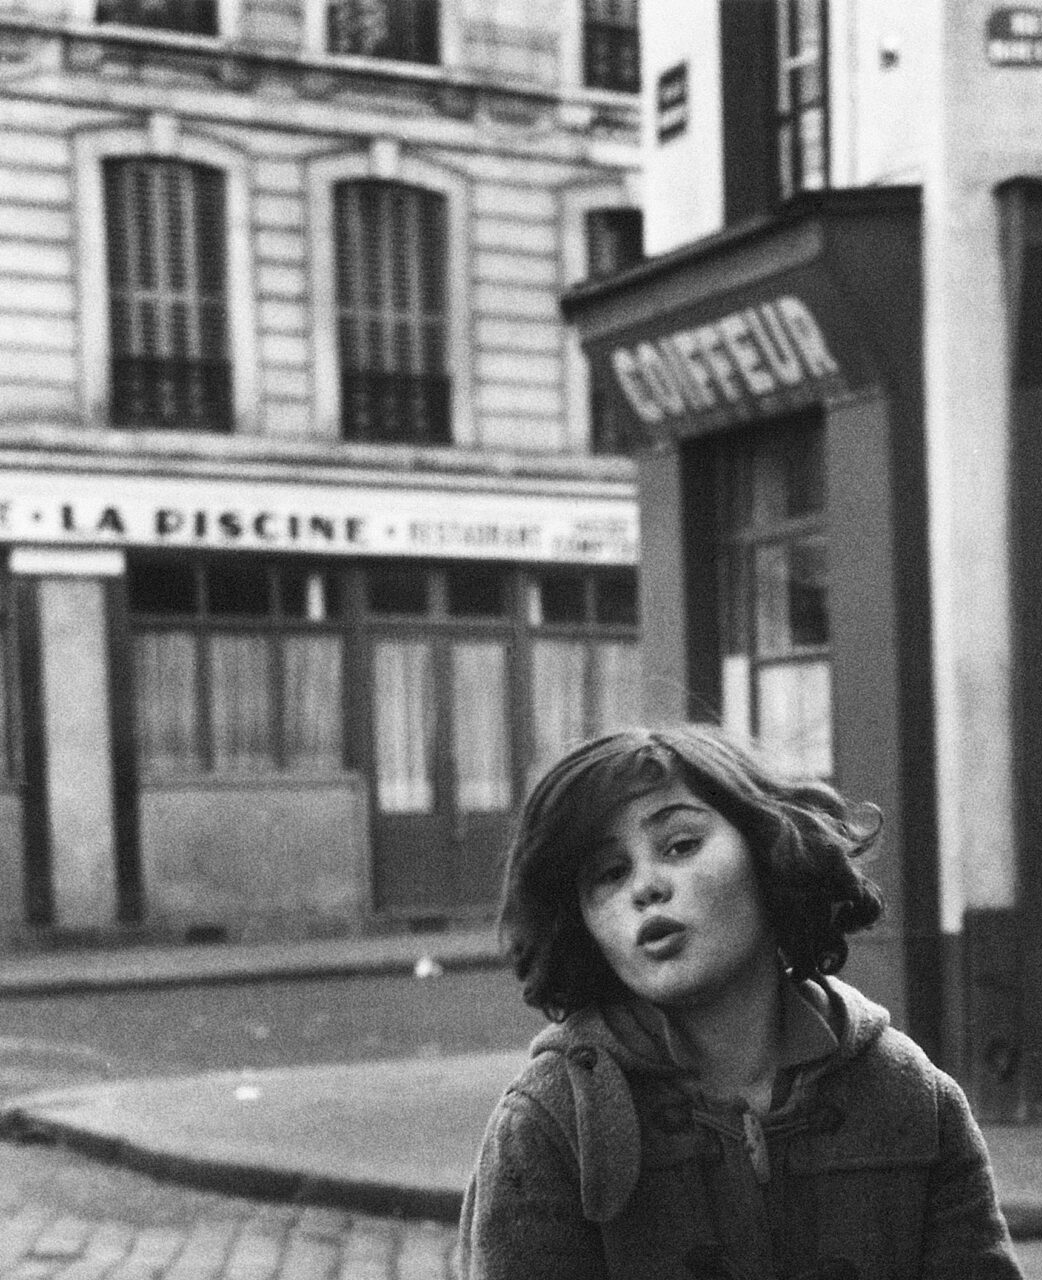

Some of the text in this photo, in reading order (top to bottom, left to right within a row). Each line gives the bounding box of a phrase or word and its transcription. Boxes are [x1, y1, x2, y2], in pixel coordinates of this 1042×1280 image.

[612, 296, 838, 422] COIFFEUR
[61, 504, 125, 534] LA
[155, 507, 366, 544] PISCINE
